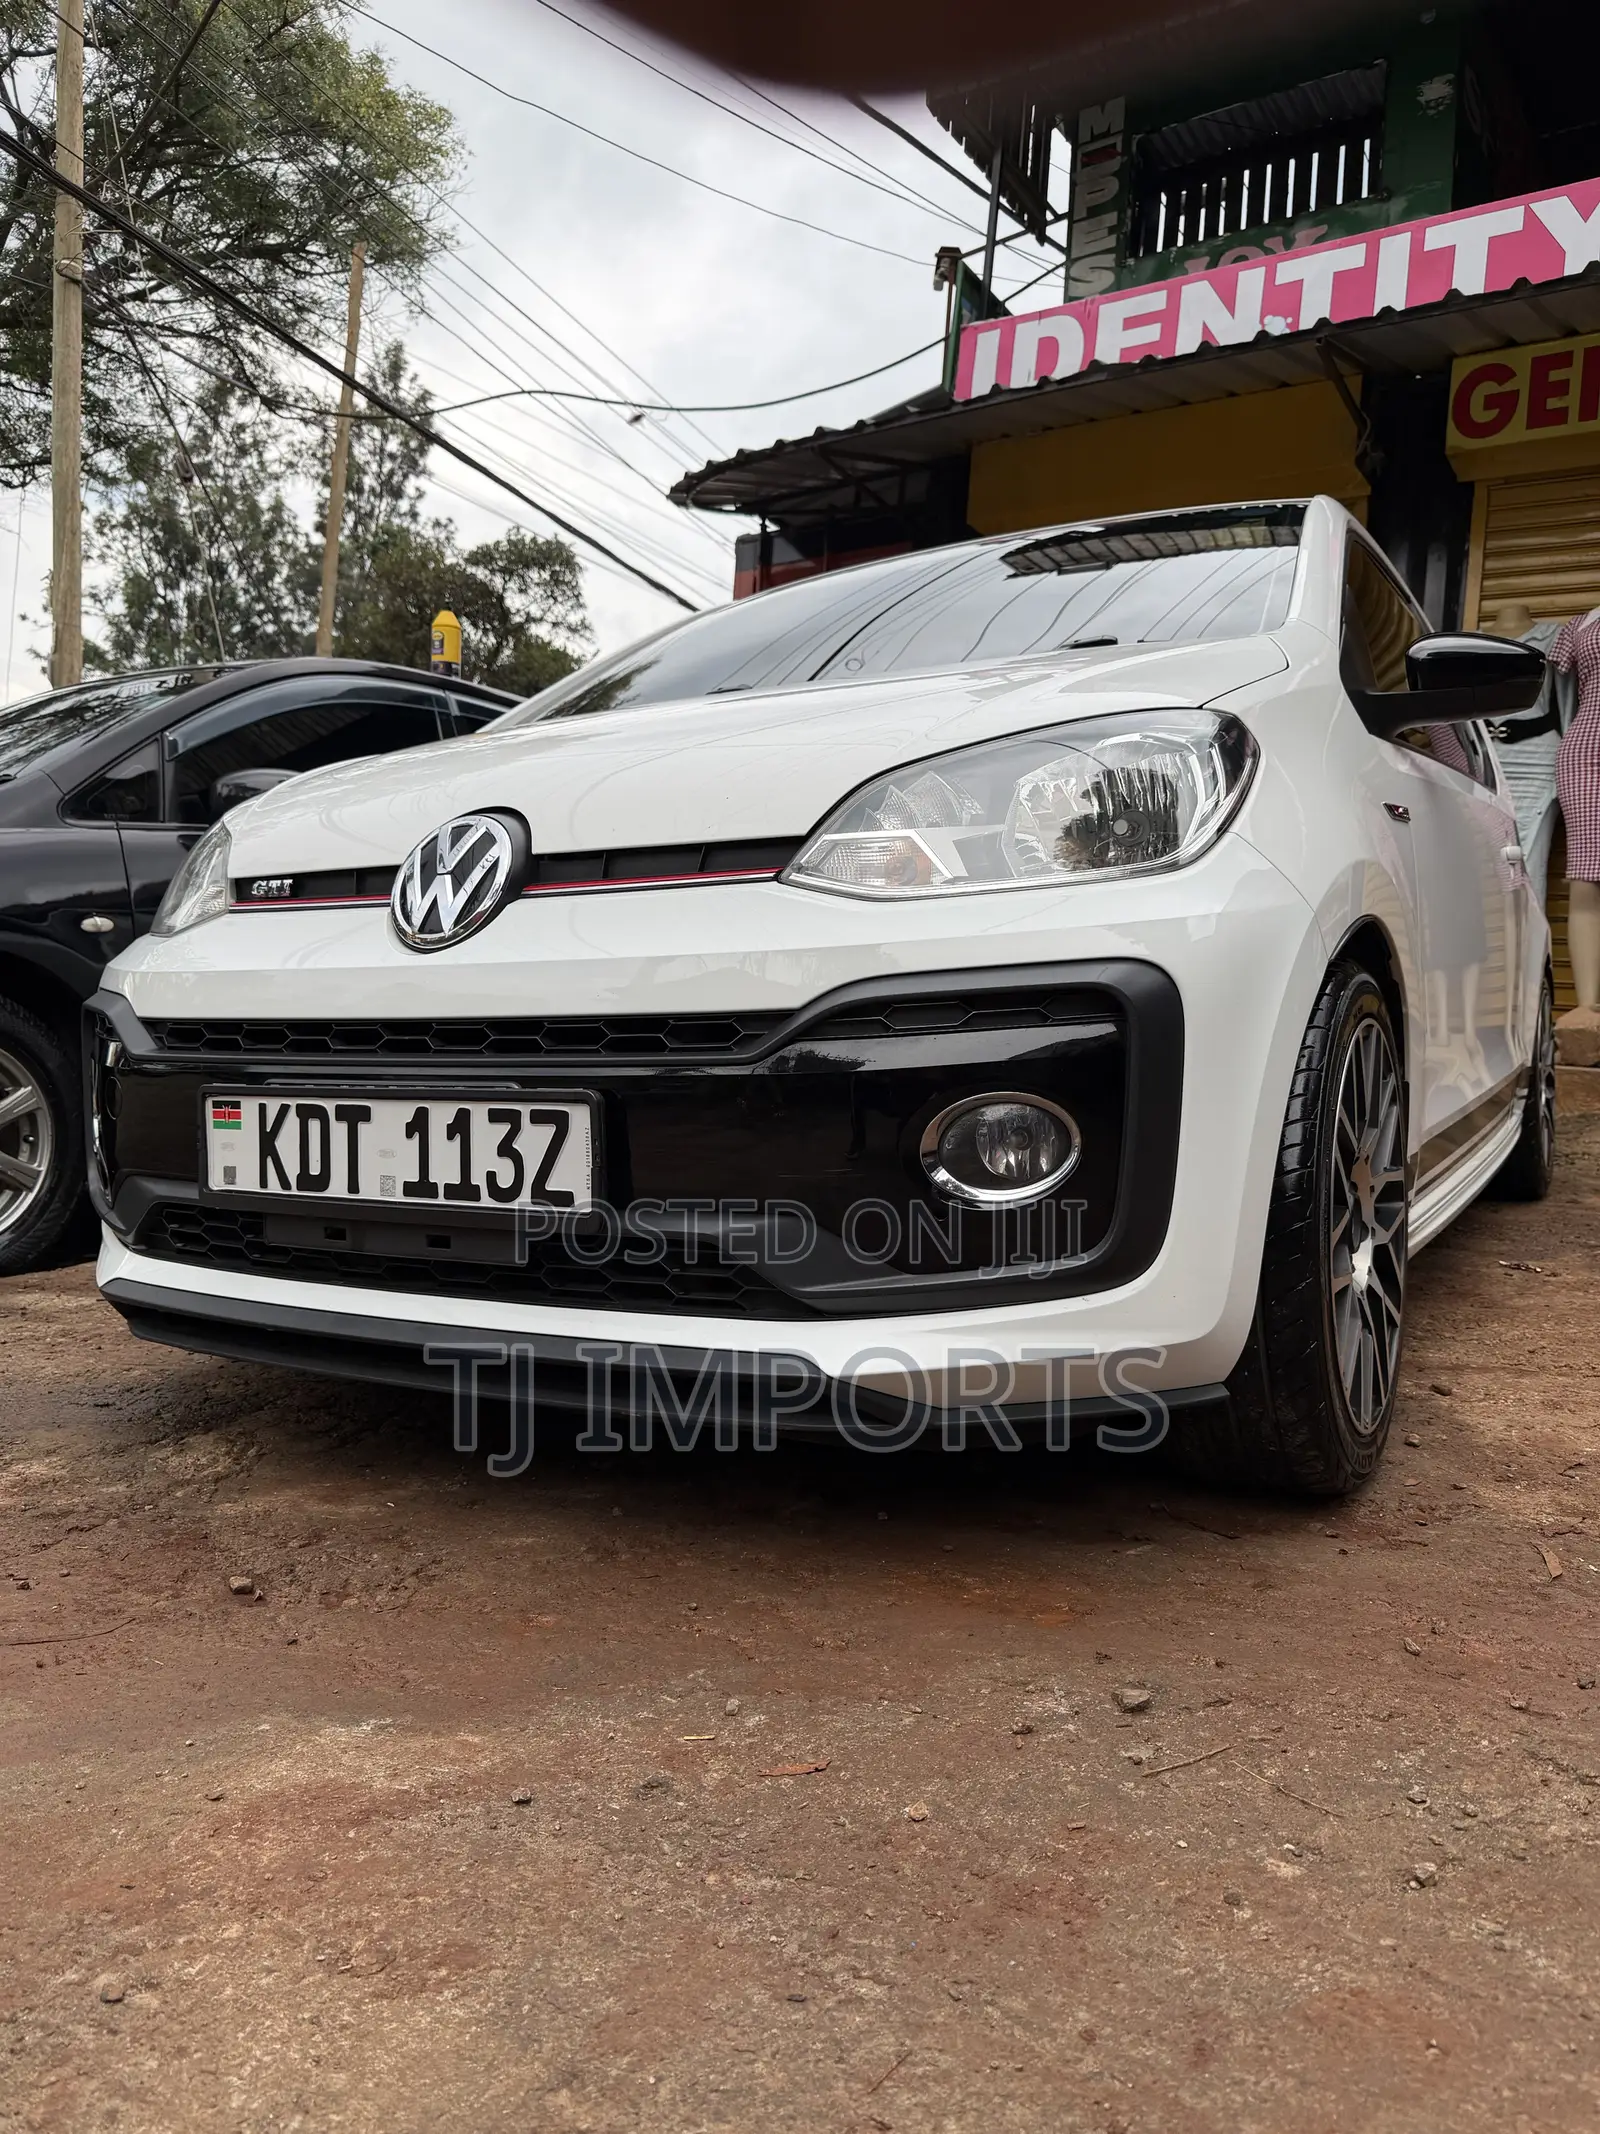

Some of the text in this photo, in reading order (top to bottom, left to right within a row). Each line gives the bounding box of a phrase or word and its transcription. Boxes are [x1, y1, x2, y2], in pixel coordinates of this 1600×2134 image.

[971, 195, 1600, 397] IDENTITY
[251, 879, 294, 897] GTI
[258, 1102, 575, 1208] KDT 1113Z
